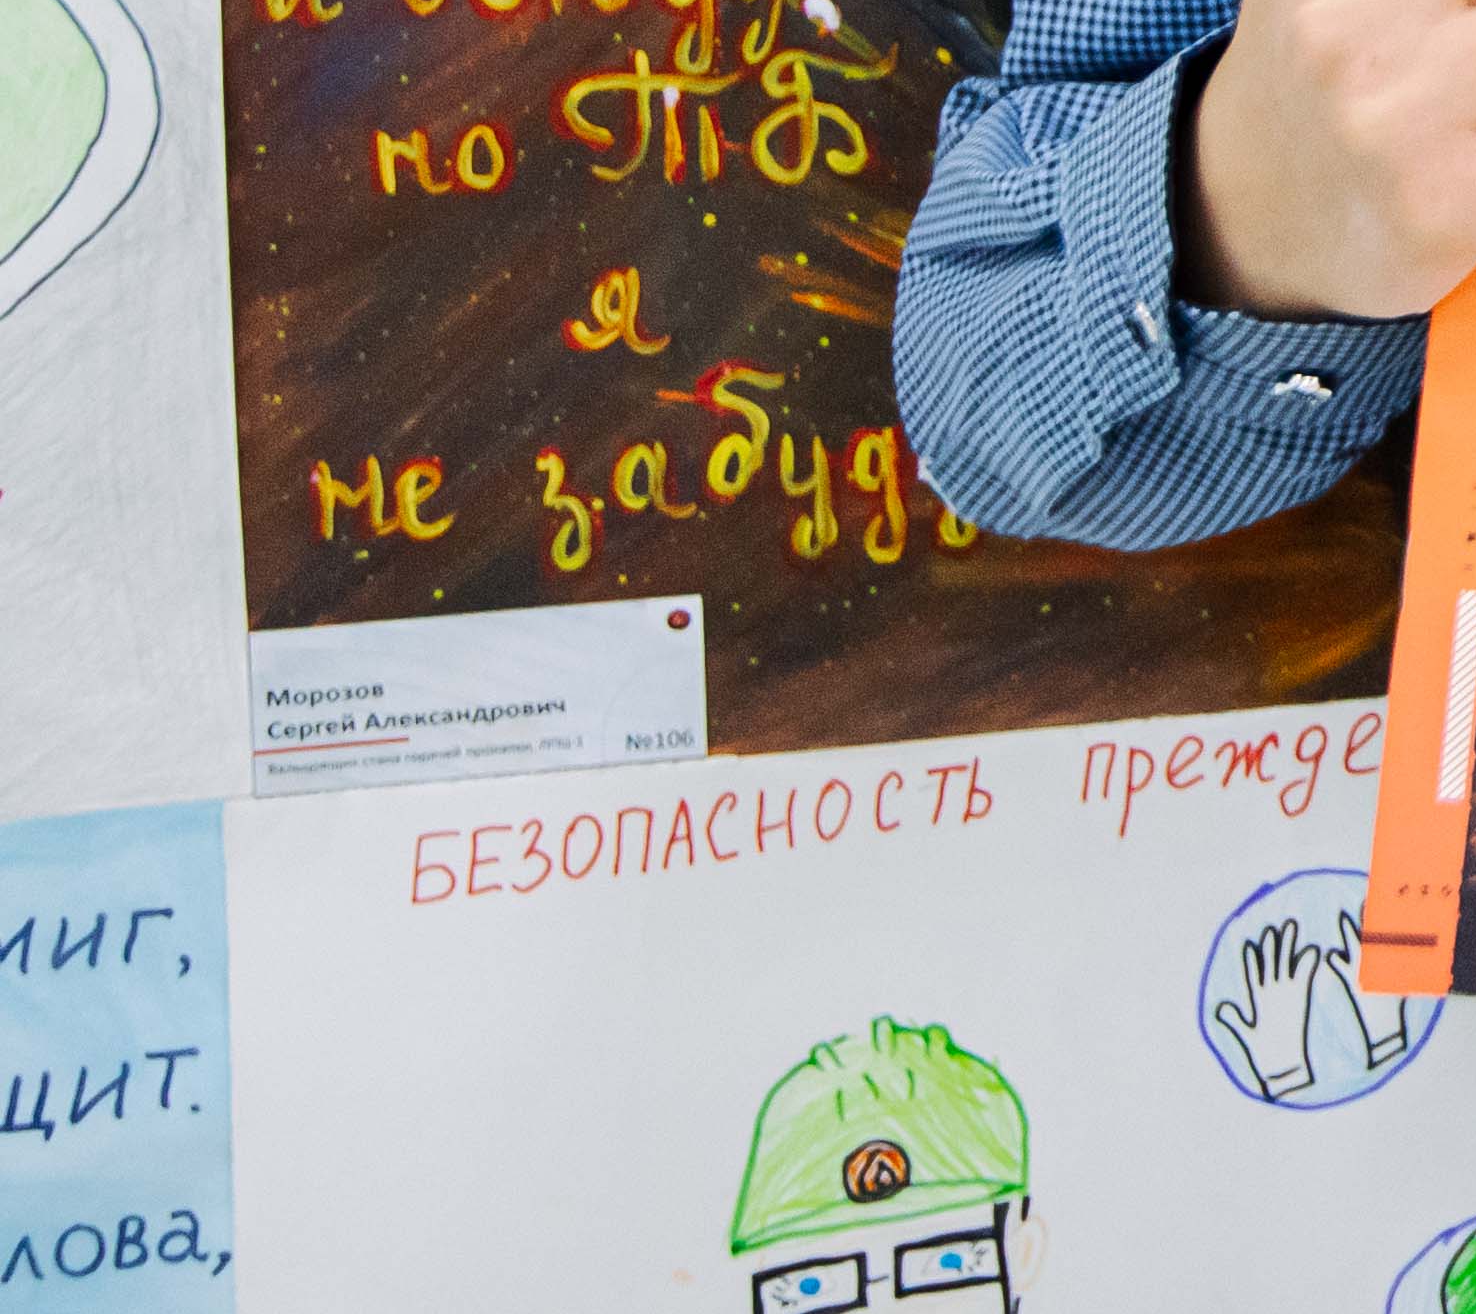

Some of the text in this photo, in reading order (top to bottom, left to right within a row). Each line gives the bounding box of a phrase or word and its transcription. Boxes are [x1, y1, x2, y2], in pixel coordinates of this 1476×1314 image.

[565, 266, 671, 355] я
[316, 454, 455, 541] не
[265, 682, 385, 709] Морозов
[267, 697, 566, 742] Сергей Александрович
[625, 729, 695, 752] №106
[410, 708, 1386, 907] БЕЗОПАСНОСТЬ прежде
